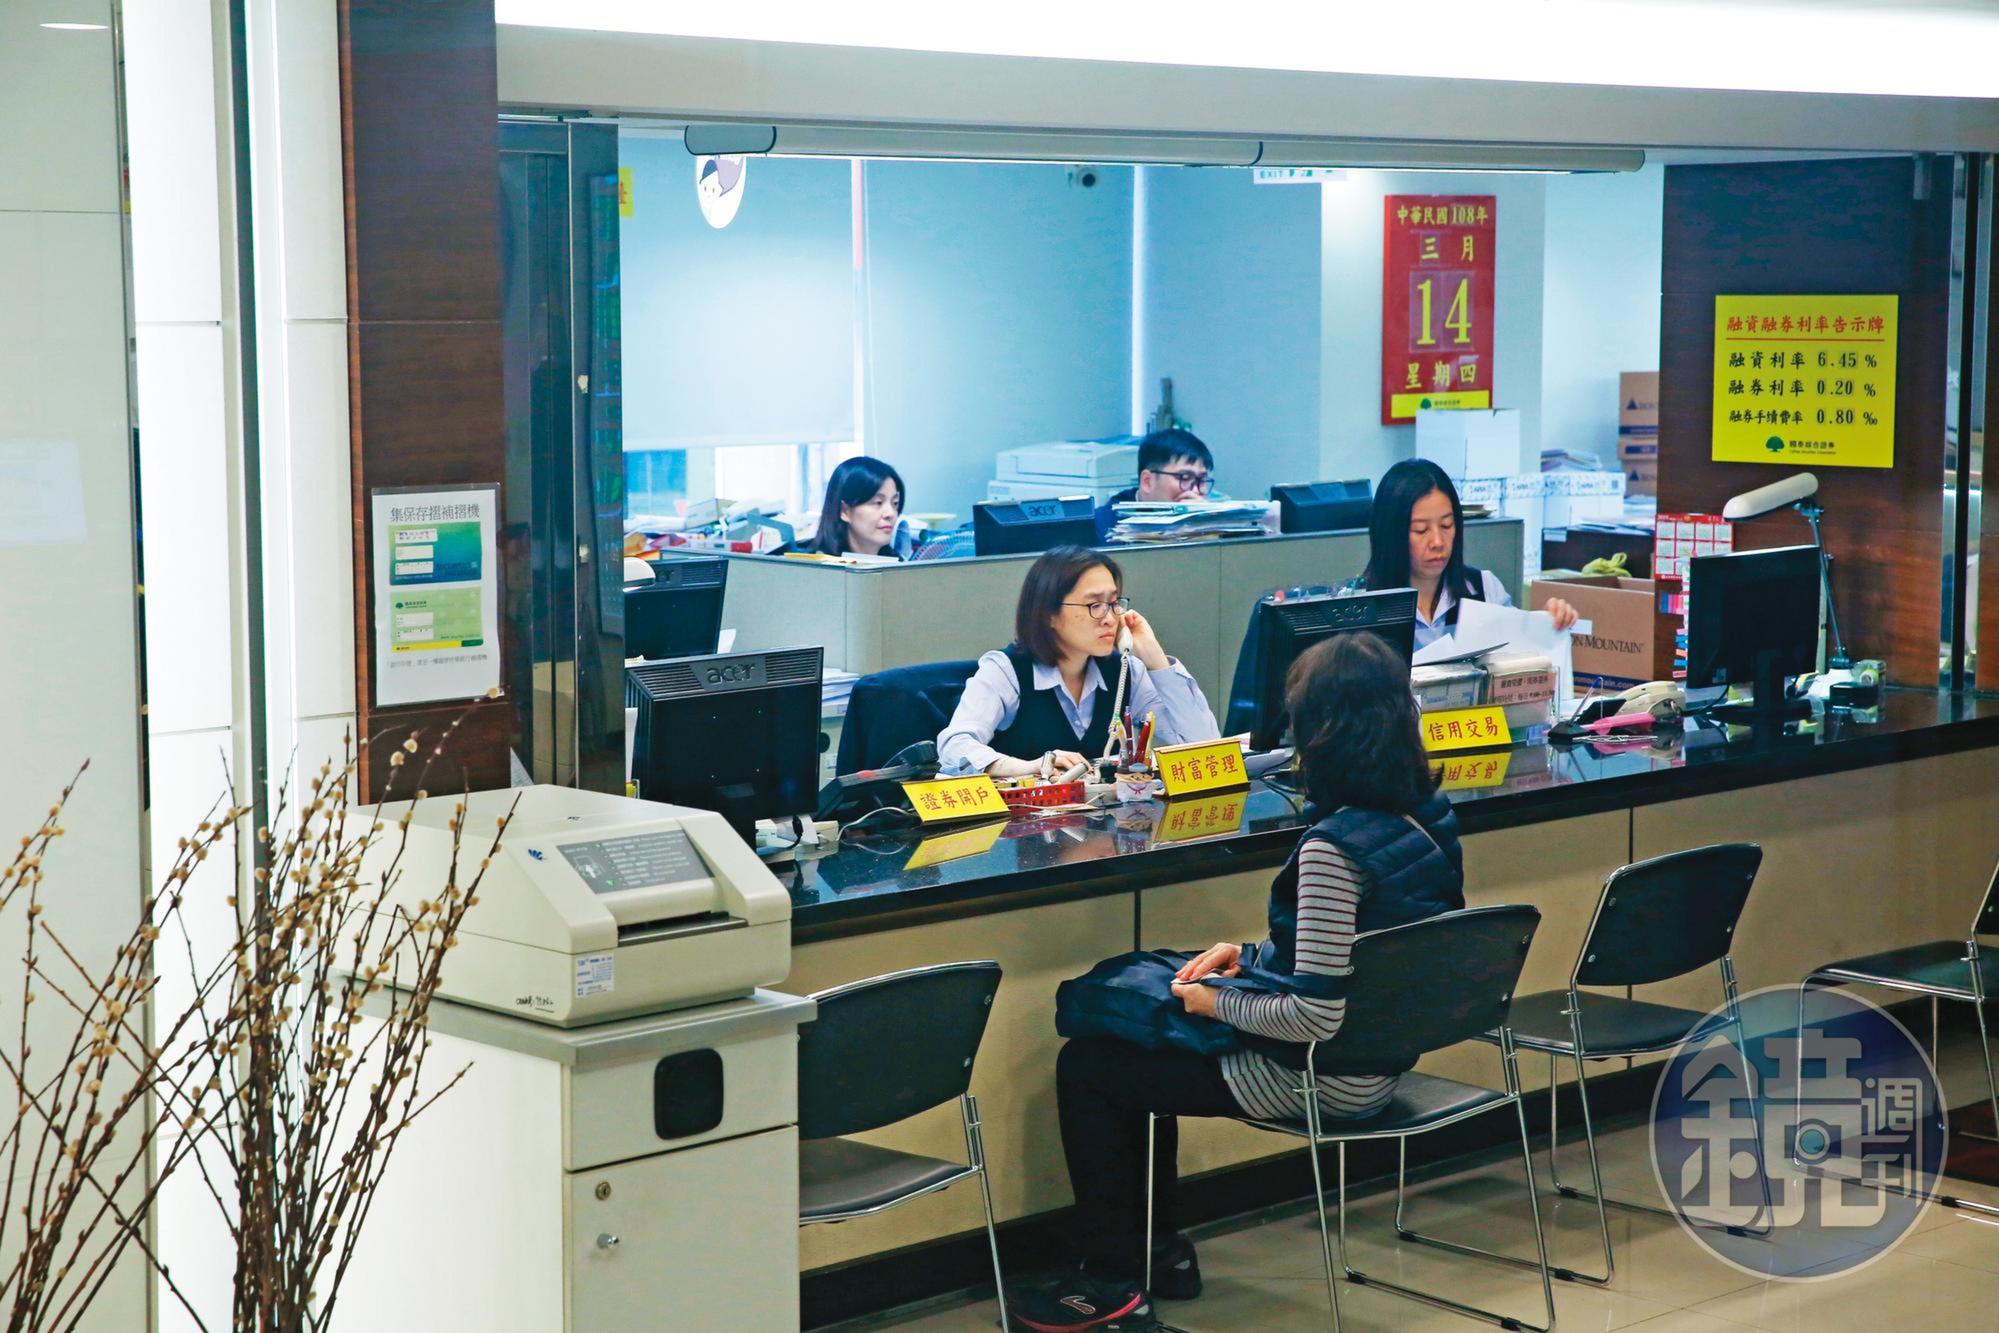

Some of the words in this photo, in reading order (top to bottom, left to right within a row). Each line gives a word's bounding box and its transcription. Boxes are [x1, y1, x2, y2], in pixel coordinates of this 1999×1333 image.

[1396, 204, 1488, 226] 中華民國108年
[1416, 278, 1473, 345] 14
[1727, 315, 1885, 334] 融資融券利率告示牌
[1729, 351, 1805, 370] 融資利率
[1817, 351, 1858, 369] 6.45
[1865, 354, 1877, 368] %
[1405, 362, 1477, 389] 星期四
[1728, 379, 1805, 397] 融券利率
[1816, 380, 1854, 396] 0.20
[1864, 384, 1876, 397] %
[1729, 409, 1803, 426] 融券手續費率
[1816, 409, 1854, 425] 0.80
[390, 503, 480, 523] 集保存摺補摺機
[1028, 504, 1056, 517] acer
[706, 660, 756, 684] acer
[1428, 716, 1499, 741] 信用交易
[1171, 754, 1238, 784] 財富管理
[920, 787, 990, 811] 證券開戶
